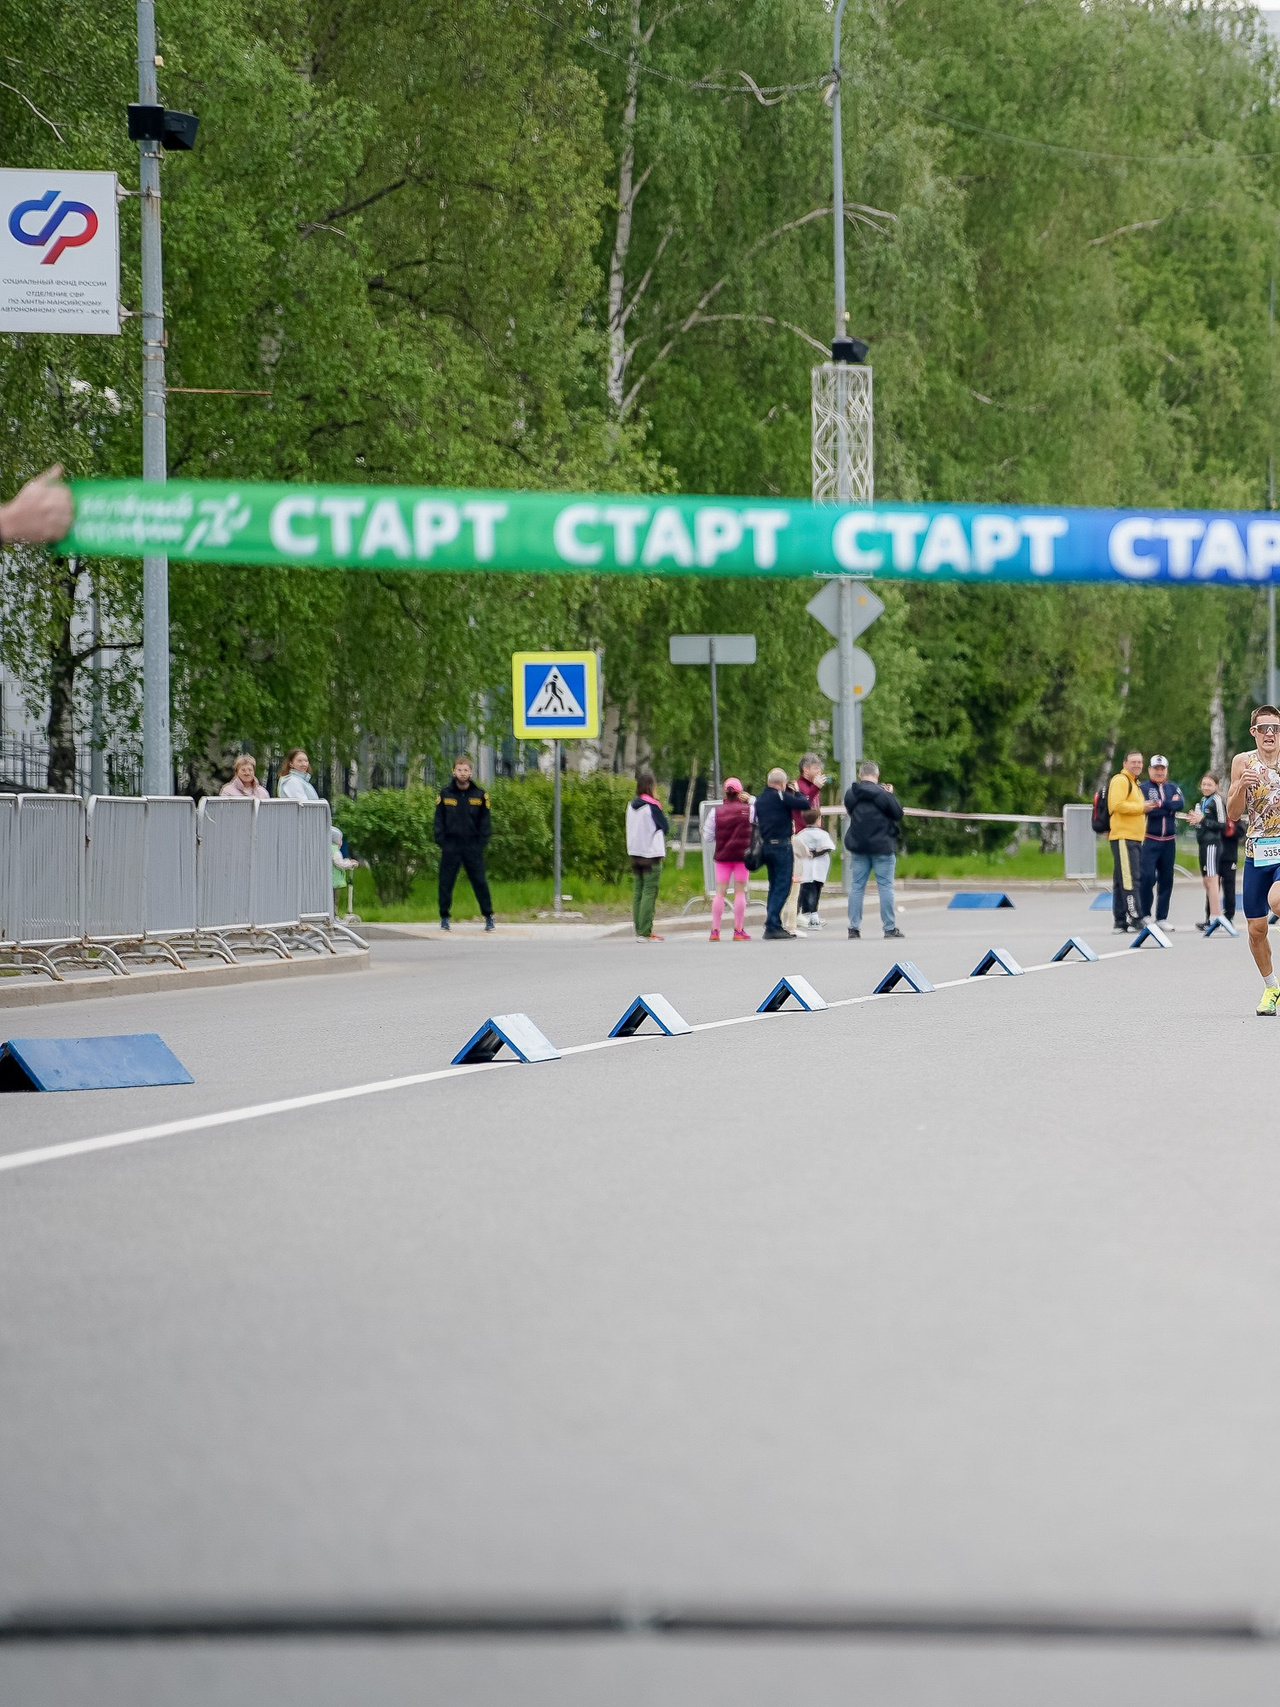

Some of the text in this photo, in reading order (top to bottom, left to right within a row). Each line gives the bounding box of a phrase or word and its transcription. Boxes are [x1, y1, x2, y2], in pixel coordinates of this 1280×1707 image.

[268, 496, 508, 563] СТАРТ
[552, 502, 790, 570] СТАРТ
[832, 511, 1069, 577] СТАРТ
